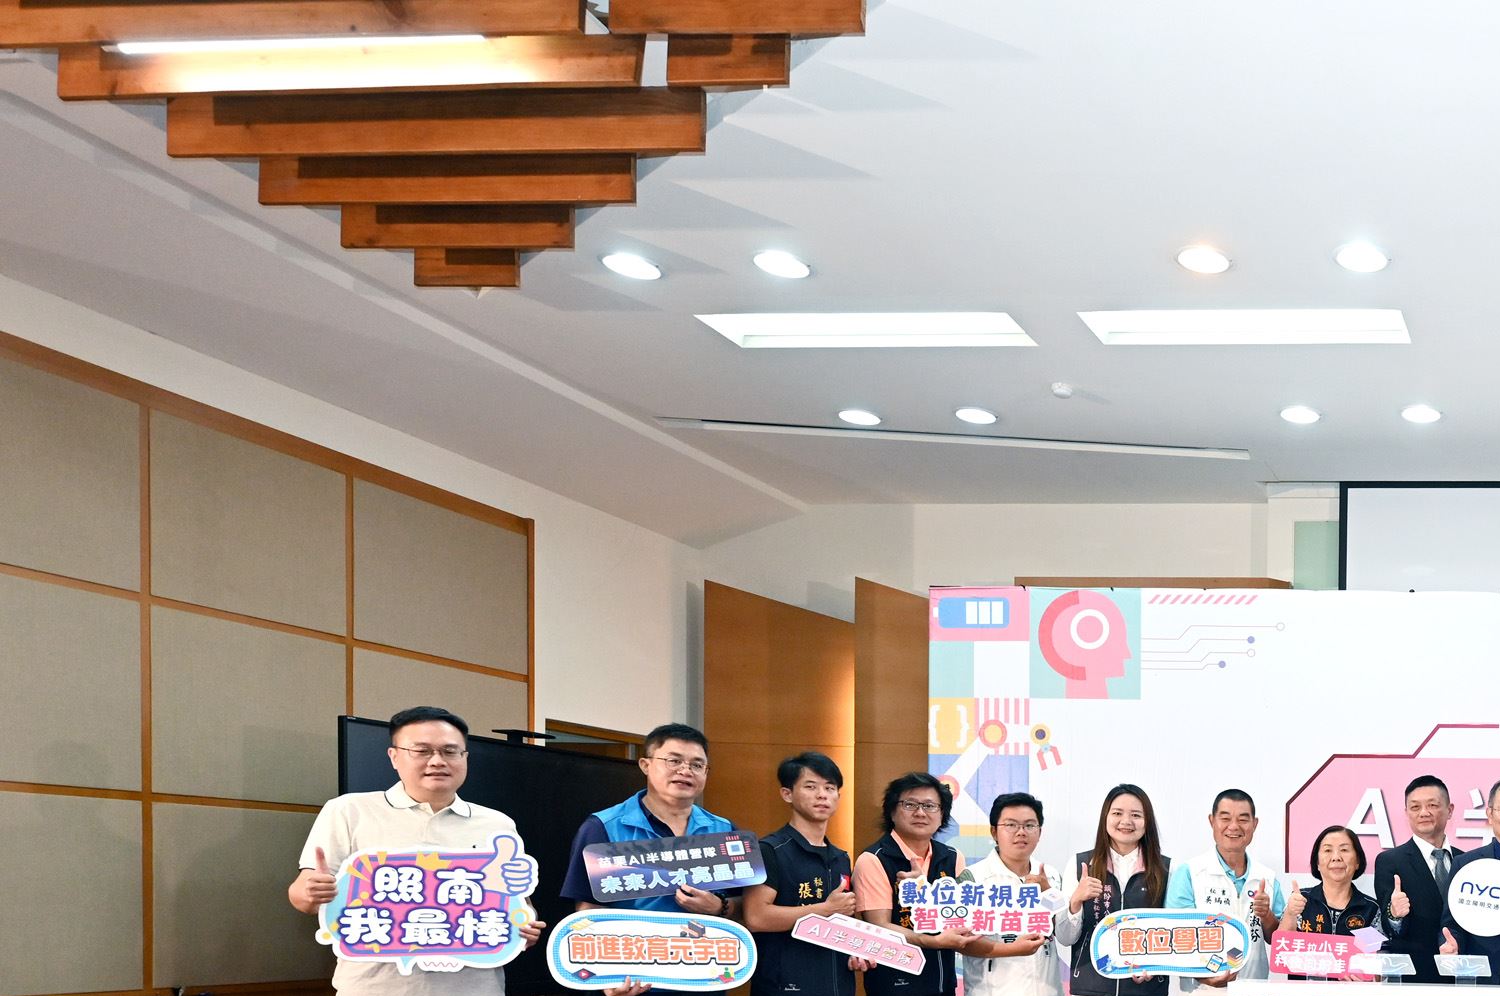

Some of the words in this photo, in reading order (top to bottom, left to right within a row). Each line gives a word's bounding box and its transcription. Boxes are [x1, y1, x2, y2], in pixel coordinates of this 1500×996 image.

[598, 847, 718, 866] 苗栗AI半導體營隊
[373, 866, 485, 905] 照南
[601, 862, 755, 894] 未來人才亮晶晶
[902, 881, 1040, 908] 數位新視界
[340, 907, 510, 946] 我最棒
[570, 935, 740, 963] 前進教育元宇宙
[808, 924, 915, 966] AI半導體營隊
[1119, 927, 1223, 955] 數位學習
[1275, 937, 1349, 956] 大手拉小手
